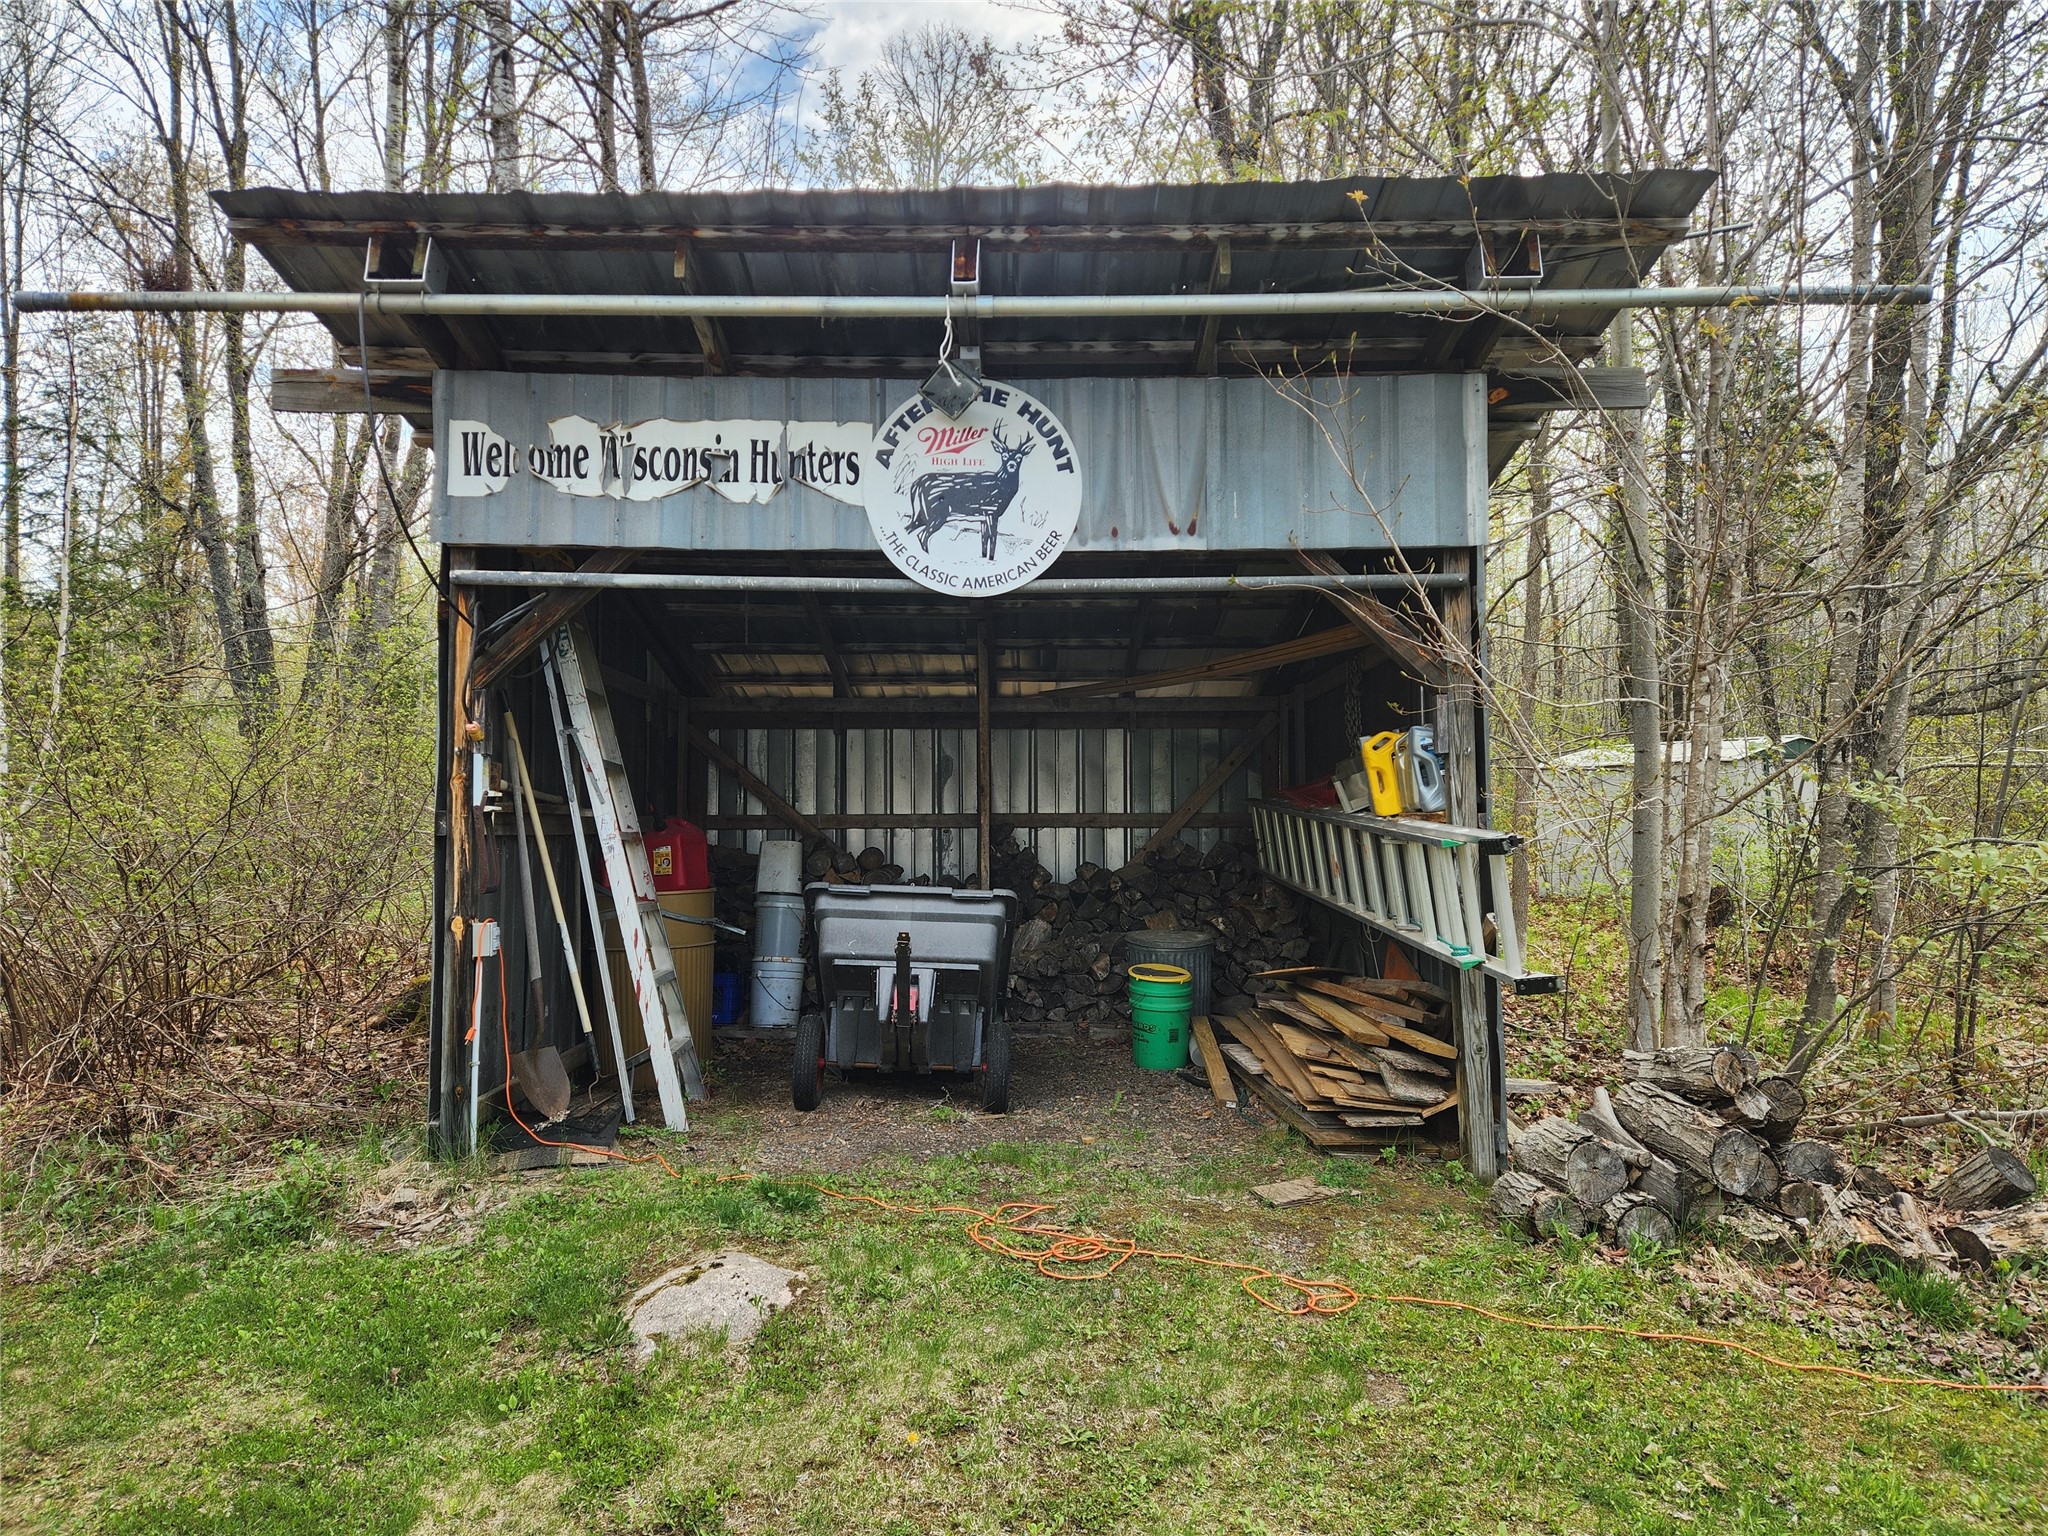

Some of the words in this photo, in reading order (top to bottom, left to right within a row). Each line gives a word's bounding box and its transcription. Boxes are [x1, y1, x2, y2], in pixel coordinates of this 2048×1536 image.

[918, 426, 989, 455] Miller
[974, 386, 1010, 408] HE
[1017, 400, 1074, 474] HUNT
[931, 457, 958, 466] HIGH
[963, 458, 985, 466] LIFE
[905, 555, 958, 587] CLASSIC
[962, 557, 1038, 589] AMERICAN
[1035, 530, 1062, 561] BEER
